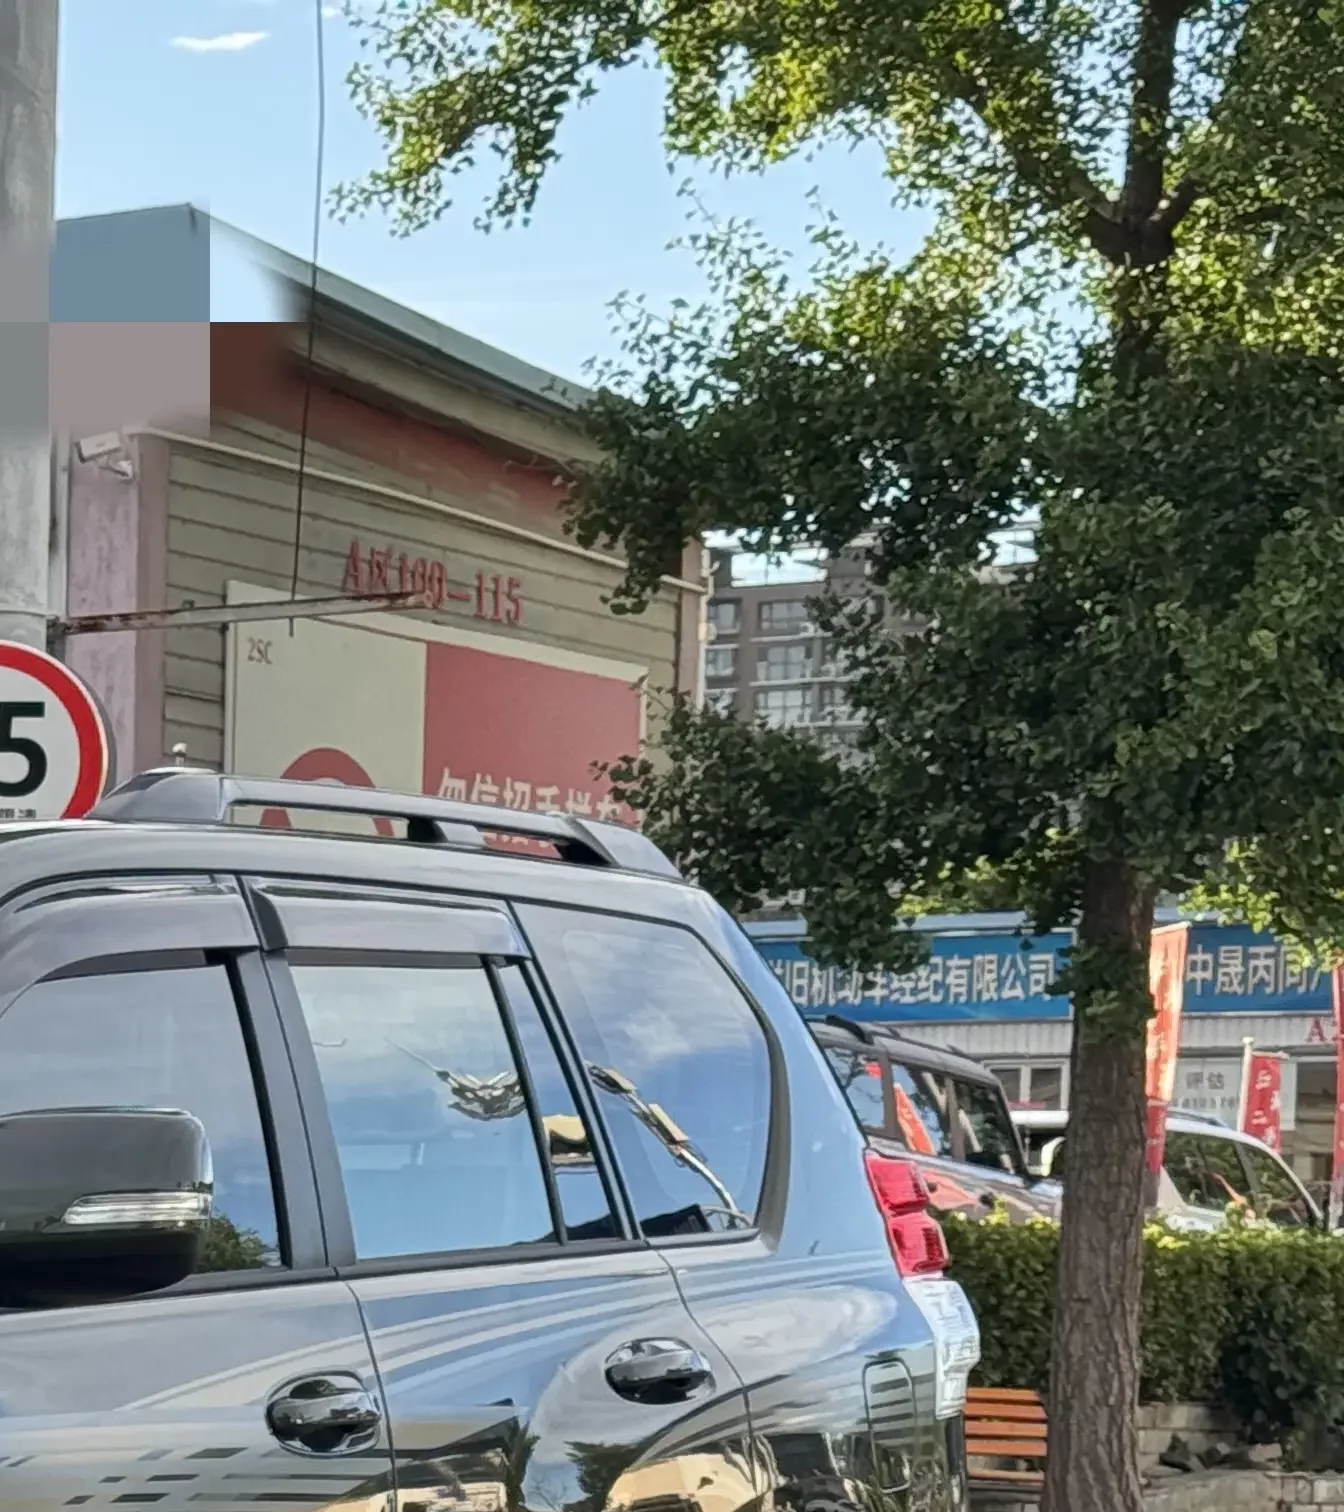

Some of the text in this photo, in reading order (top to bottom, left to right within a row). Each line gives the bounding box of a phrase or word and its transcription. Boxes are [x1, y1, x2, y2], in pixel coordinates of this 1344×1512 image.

[768, 953, 1059, 1007] 旧机动车经纪有限公司
